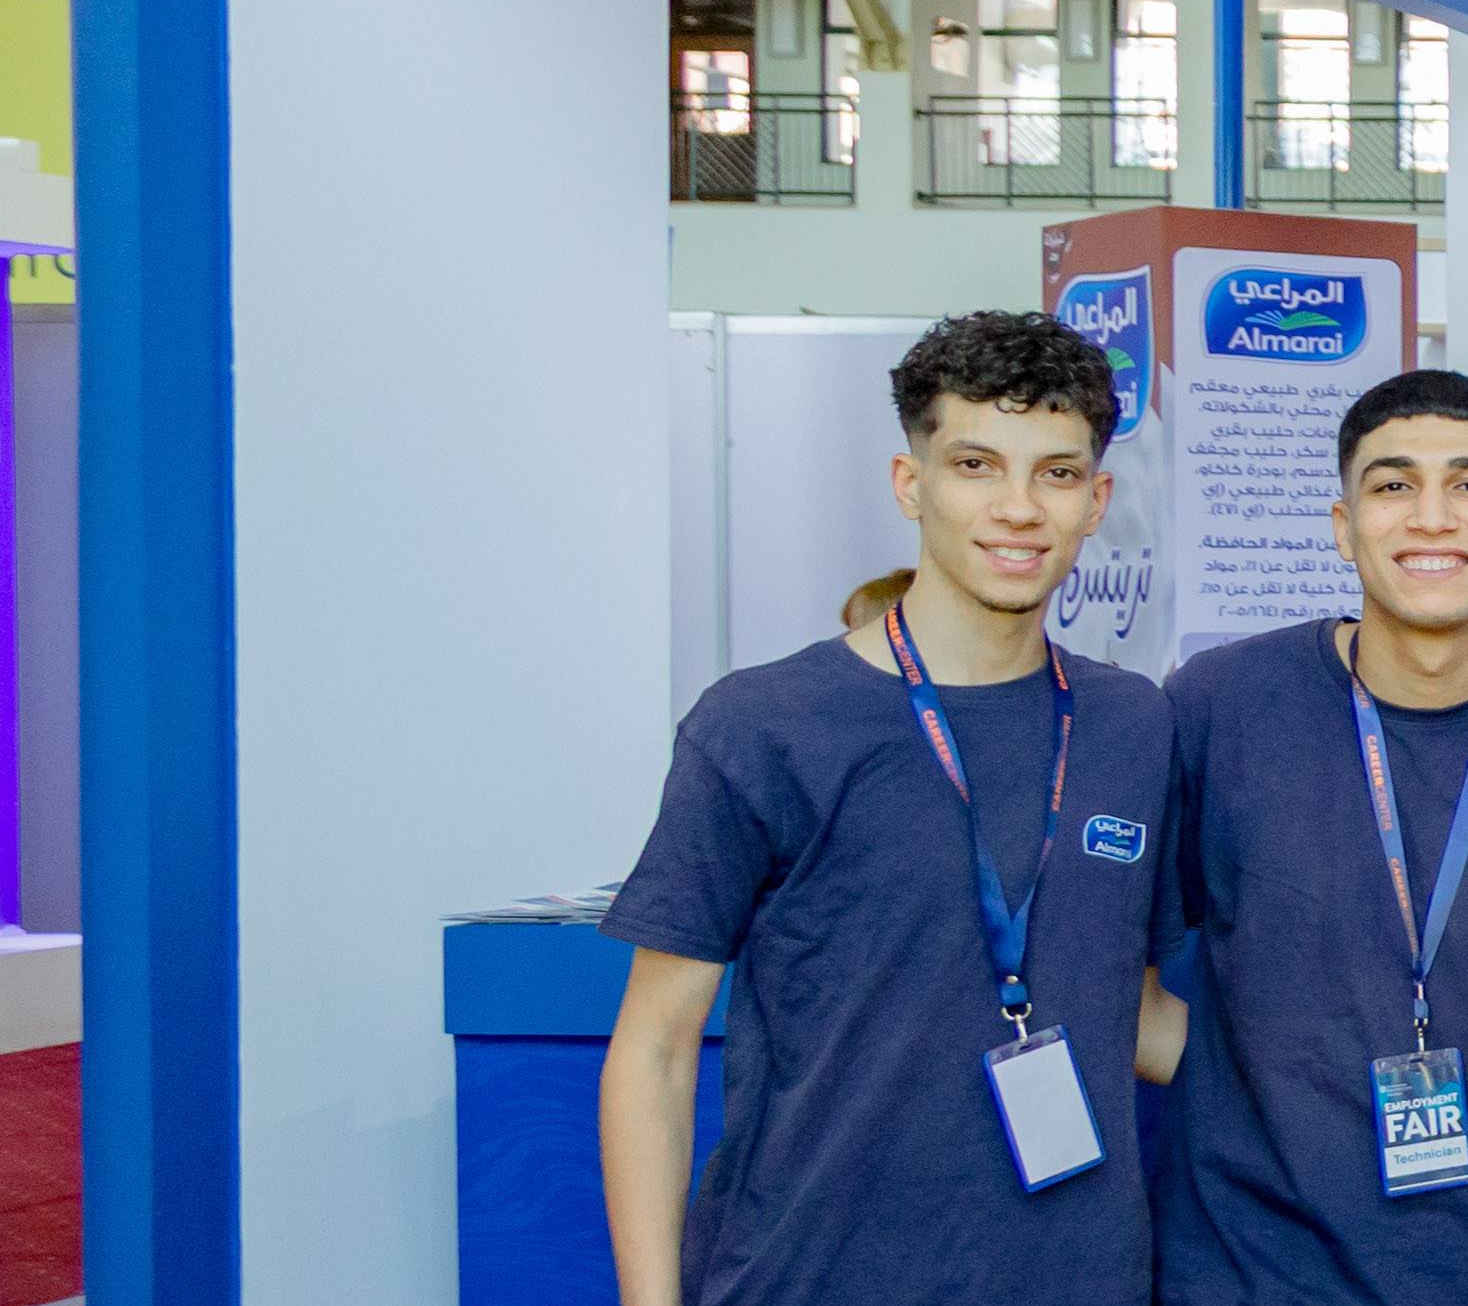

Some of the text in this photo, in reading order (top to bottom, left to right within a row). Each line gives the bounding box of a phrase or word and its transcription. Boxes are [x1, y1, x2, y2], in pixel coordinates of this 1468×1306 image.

[1229, 278, 1345, 310] المراعي
[1228, 326, 1344, 354] Almarai
[1384, 1091, 1459, 1113] EMPLOYMENT
[1385, 1105, 1463, 1144] FAIR
[1393, 1146, 1463, 1165] Technician
